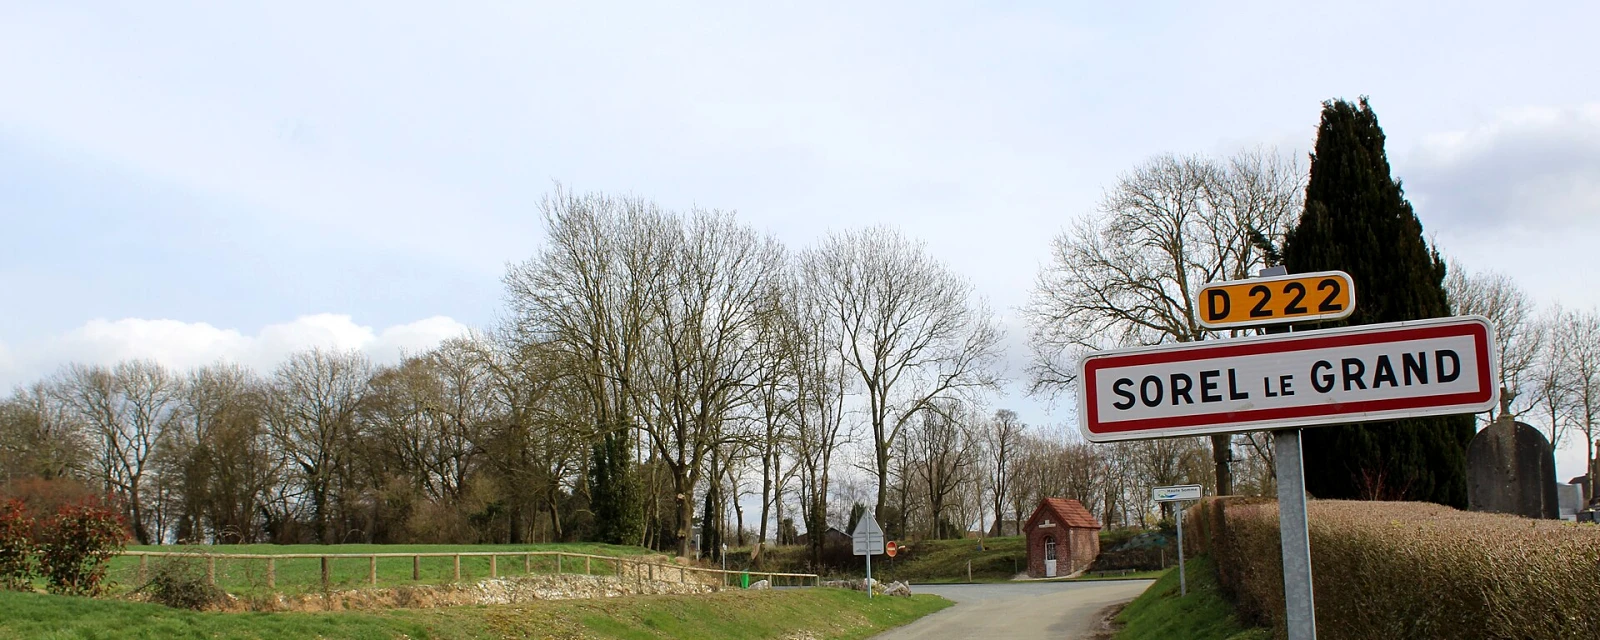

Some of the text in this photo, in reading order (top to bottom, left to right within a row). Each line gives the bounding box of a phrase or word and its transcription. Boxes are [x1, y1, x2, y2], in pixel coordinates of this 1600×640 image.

[1207, 279, 1343, 321] D 222
[1112, 349, 1461, 410] SOREL LE GRAND
